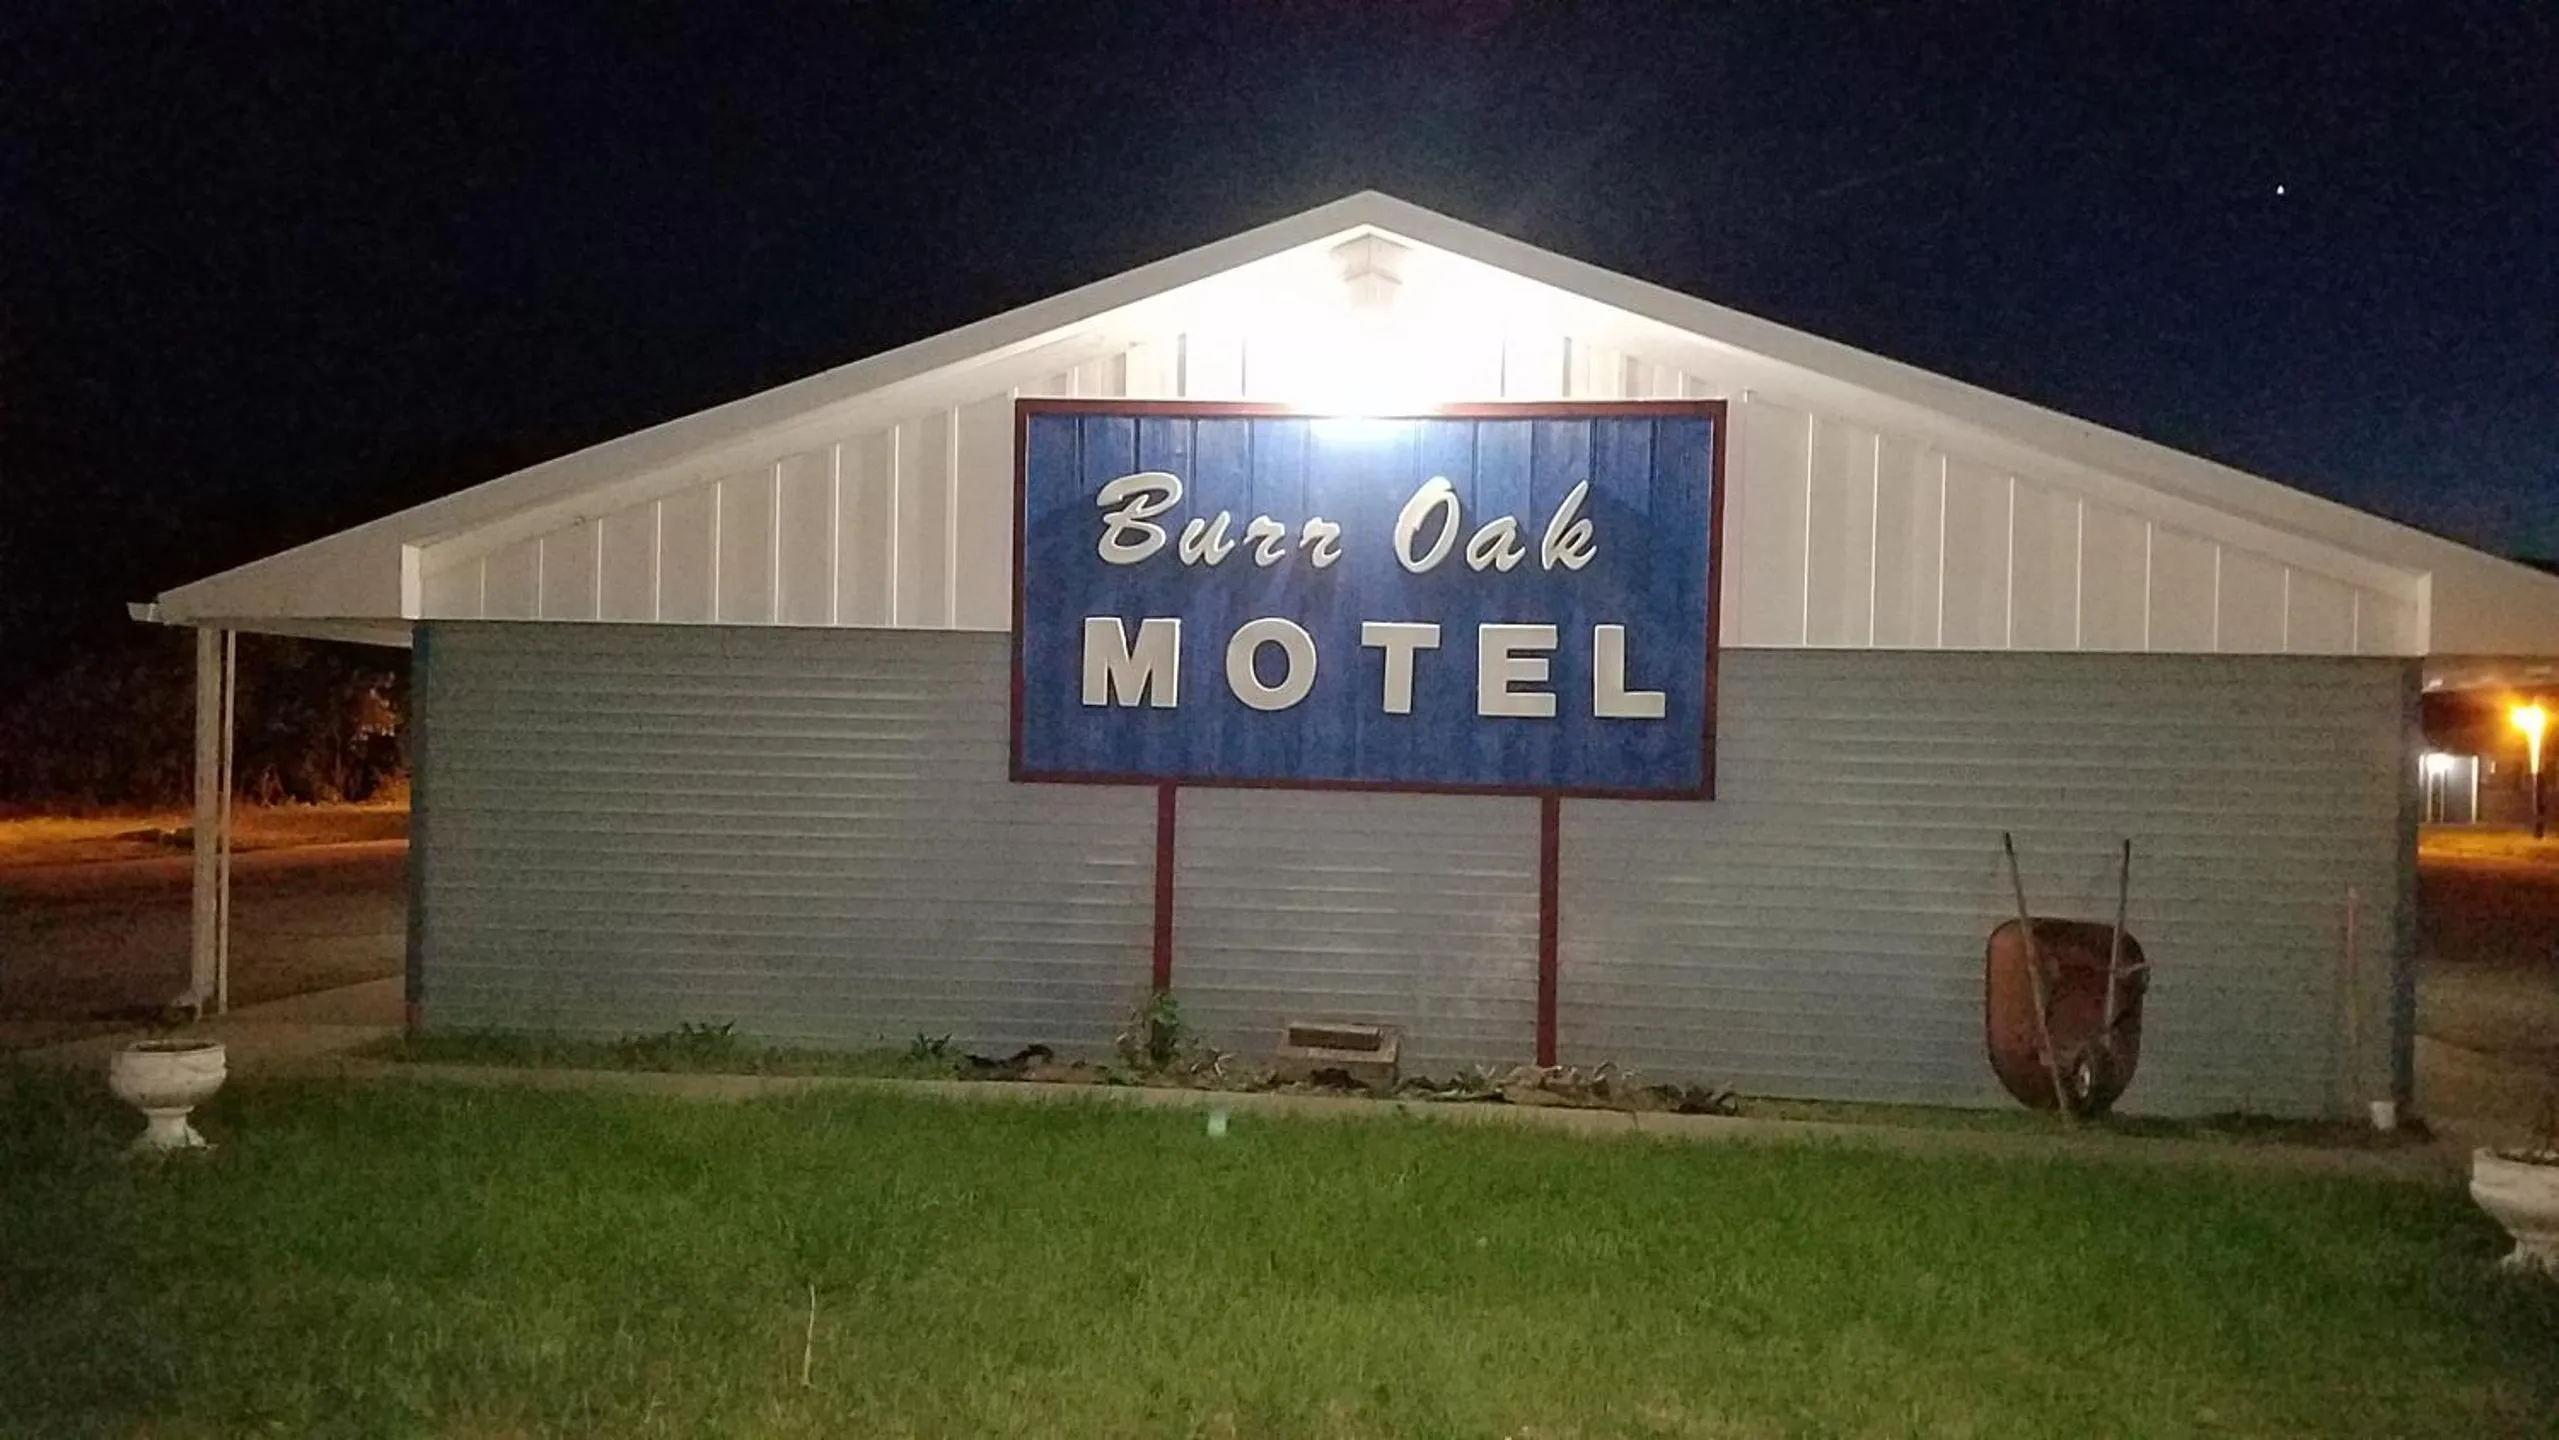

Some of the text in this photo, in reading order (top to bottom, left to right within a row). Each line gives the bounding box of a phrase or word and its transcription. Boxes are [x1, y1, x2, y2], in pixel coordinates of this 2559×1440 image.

[1096, 470, 1598, 575] Burr Oak
[1081, 616, 1667, 718] MOTEL
